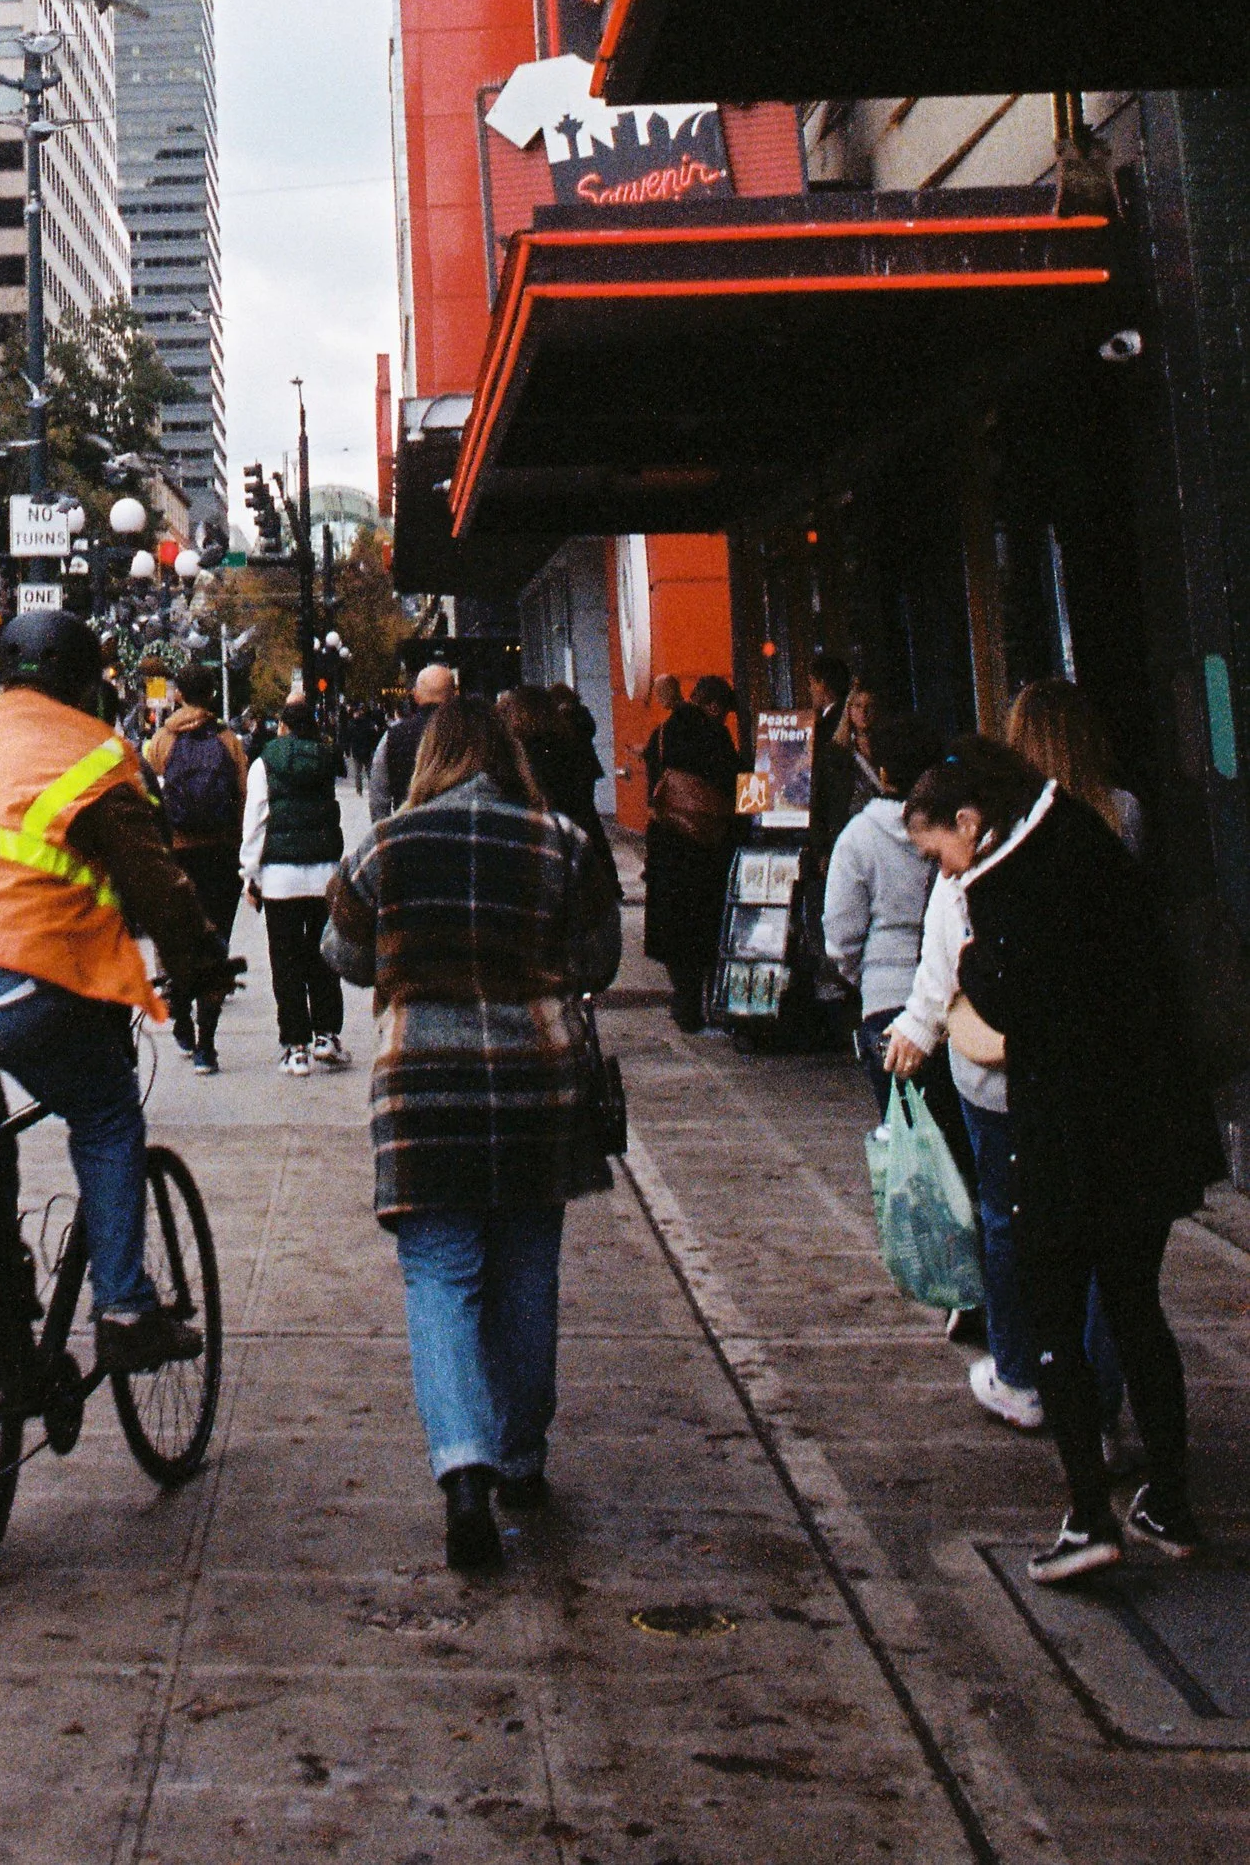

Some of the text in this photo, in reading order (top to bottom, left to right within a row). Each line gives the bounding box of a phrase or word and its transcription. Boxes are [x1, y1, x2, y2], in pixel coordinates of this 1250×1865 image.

[28, 507, 53, 523] NO
[15, 532, 66, 547] TURNS
[24, 589, 57, 604] ONE
[758, 713, 798, 727] Peace
